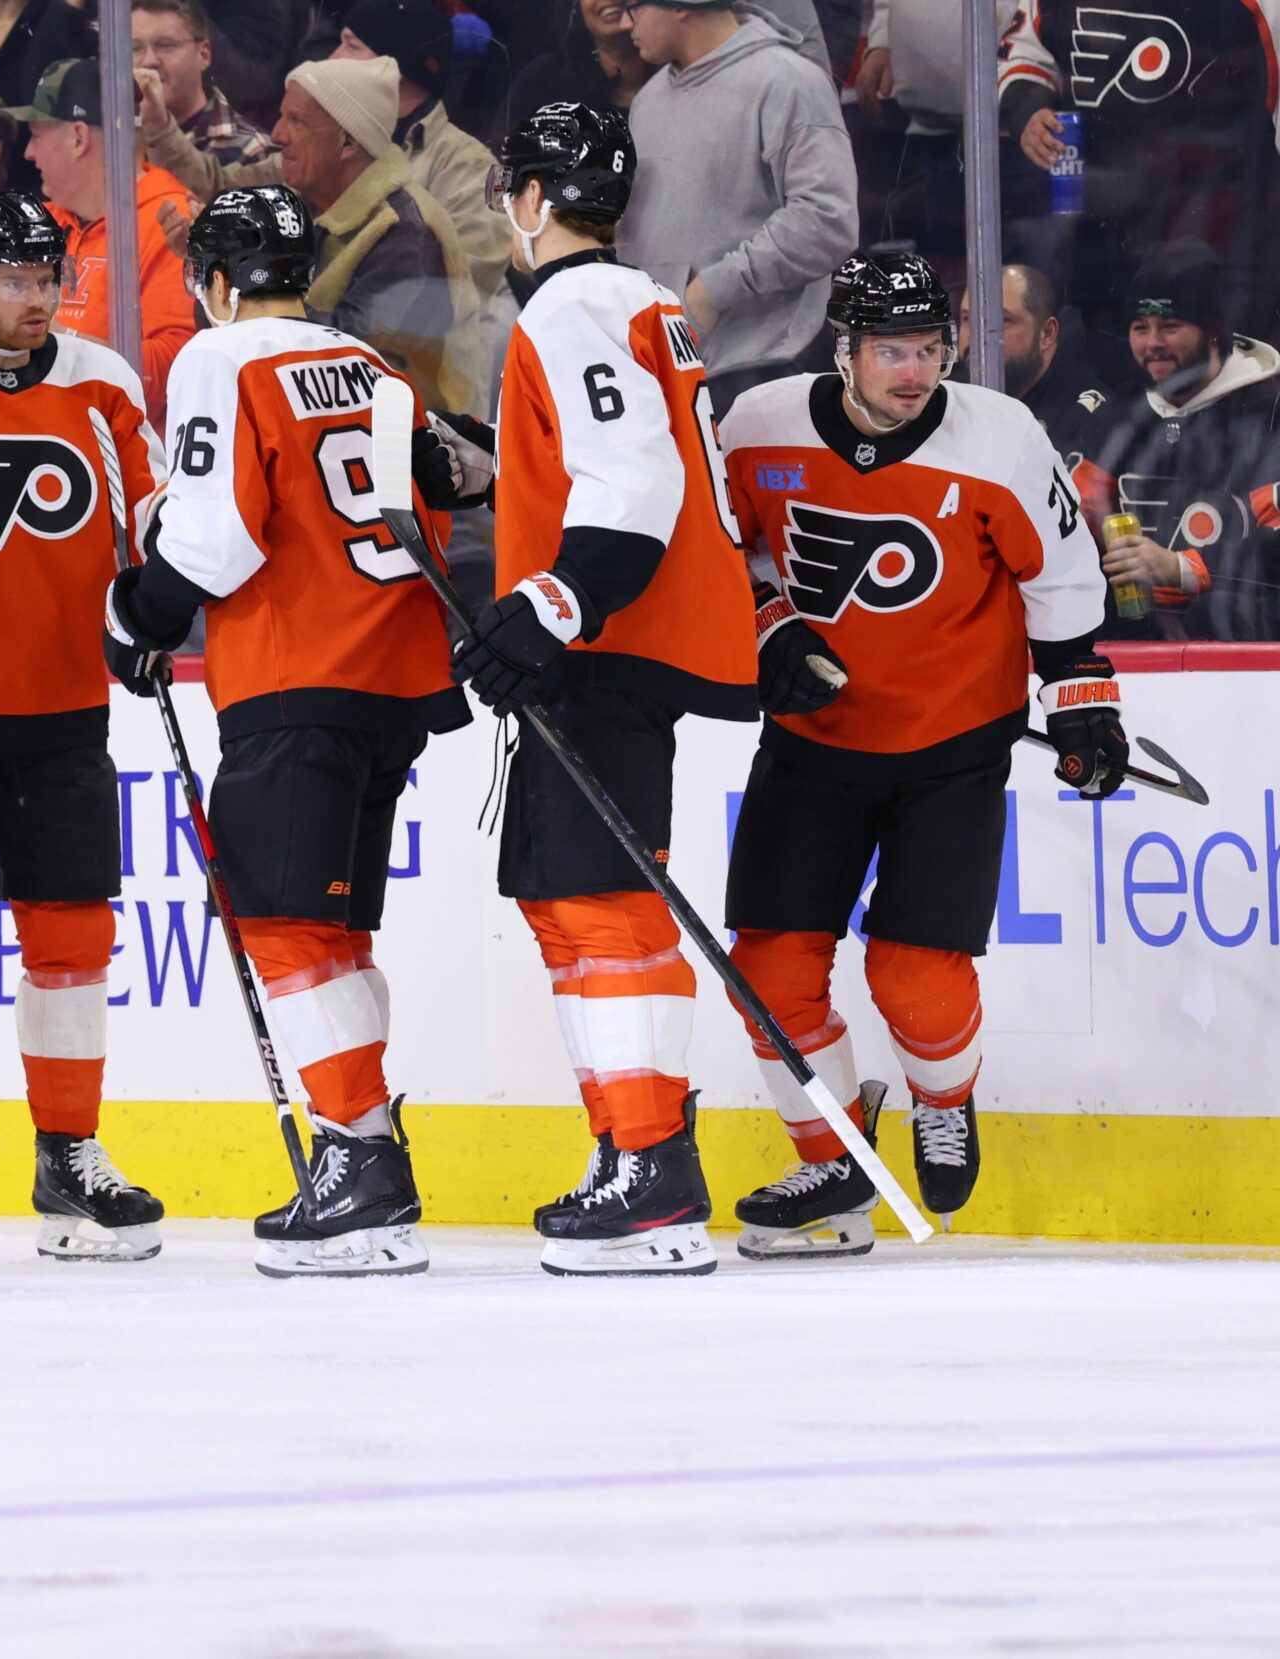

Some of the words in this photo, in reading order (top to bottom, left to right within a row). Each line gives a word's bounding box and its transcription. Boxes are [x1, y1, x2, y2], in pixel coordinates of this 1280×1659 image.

[612, 150, 625, 173] 6
[1050, 161, 1085, 176] GHT
[276, 209, 300, 236] 96
[889, 271, 917, 290] 21
[892, 302, 932, 314] CCM
[666, 320, 702, 365] AN
[582, 362, 626, 423] 6
[756, 469, 807, 491] IBX
[312, 423, 426, 587] 9
[935, 482, 961, 519] A
